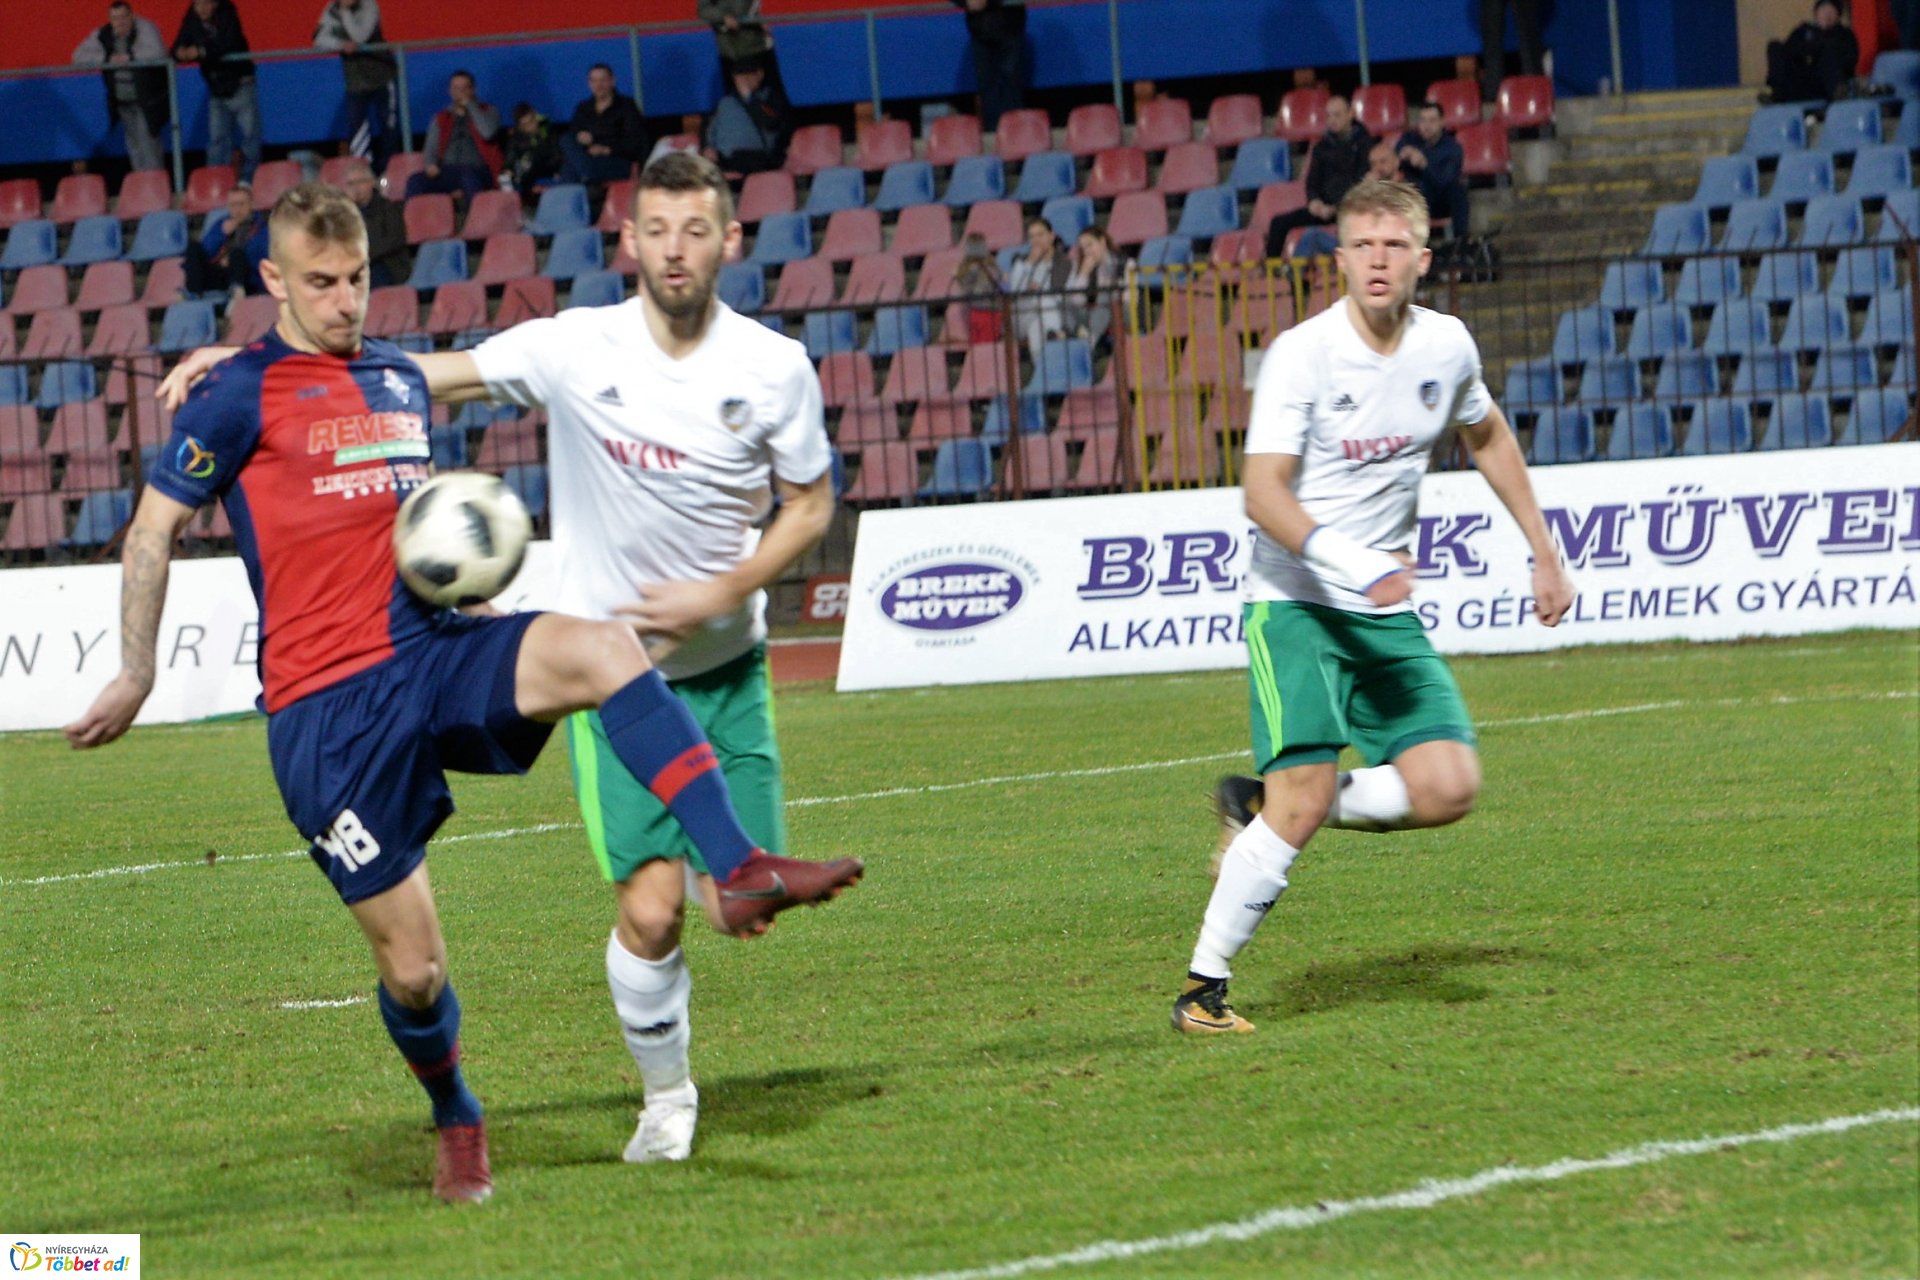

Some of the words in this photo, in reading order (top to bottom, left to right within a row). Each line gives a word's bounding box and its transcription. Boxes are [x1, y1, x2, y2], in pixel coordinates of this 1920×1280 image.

[896, 571, 1012, 598] BREKK
[1456, 583, 1722, 630] GÉPLEMEK
[1736, 564, 1918, 613] GYÁRTÁ
